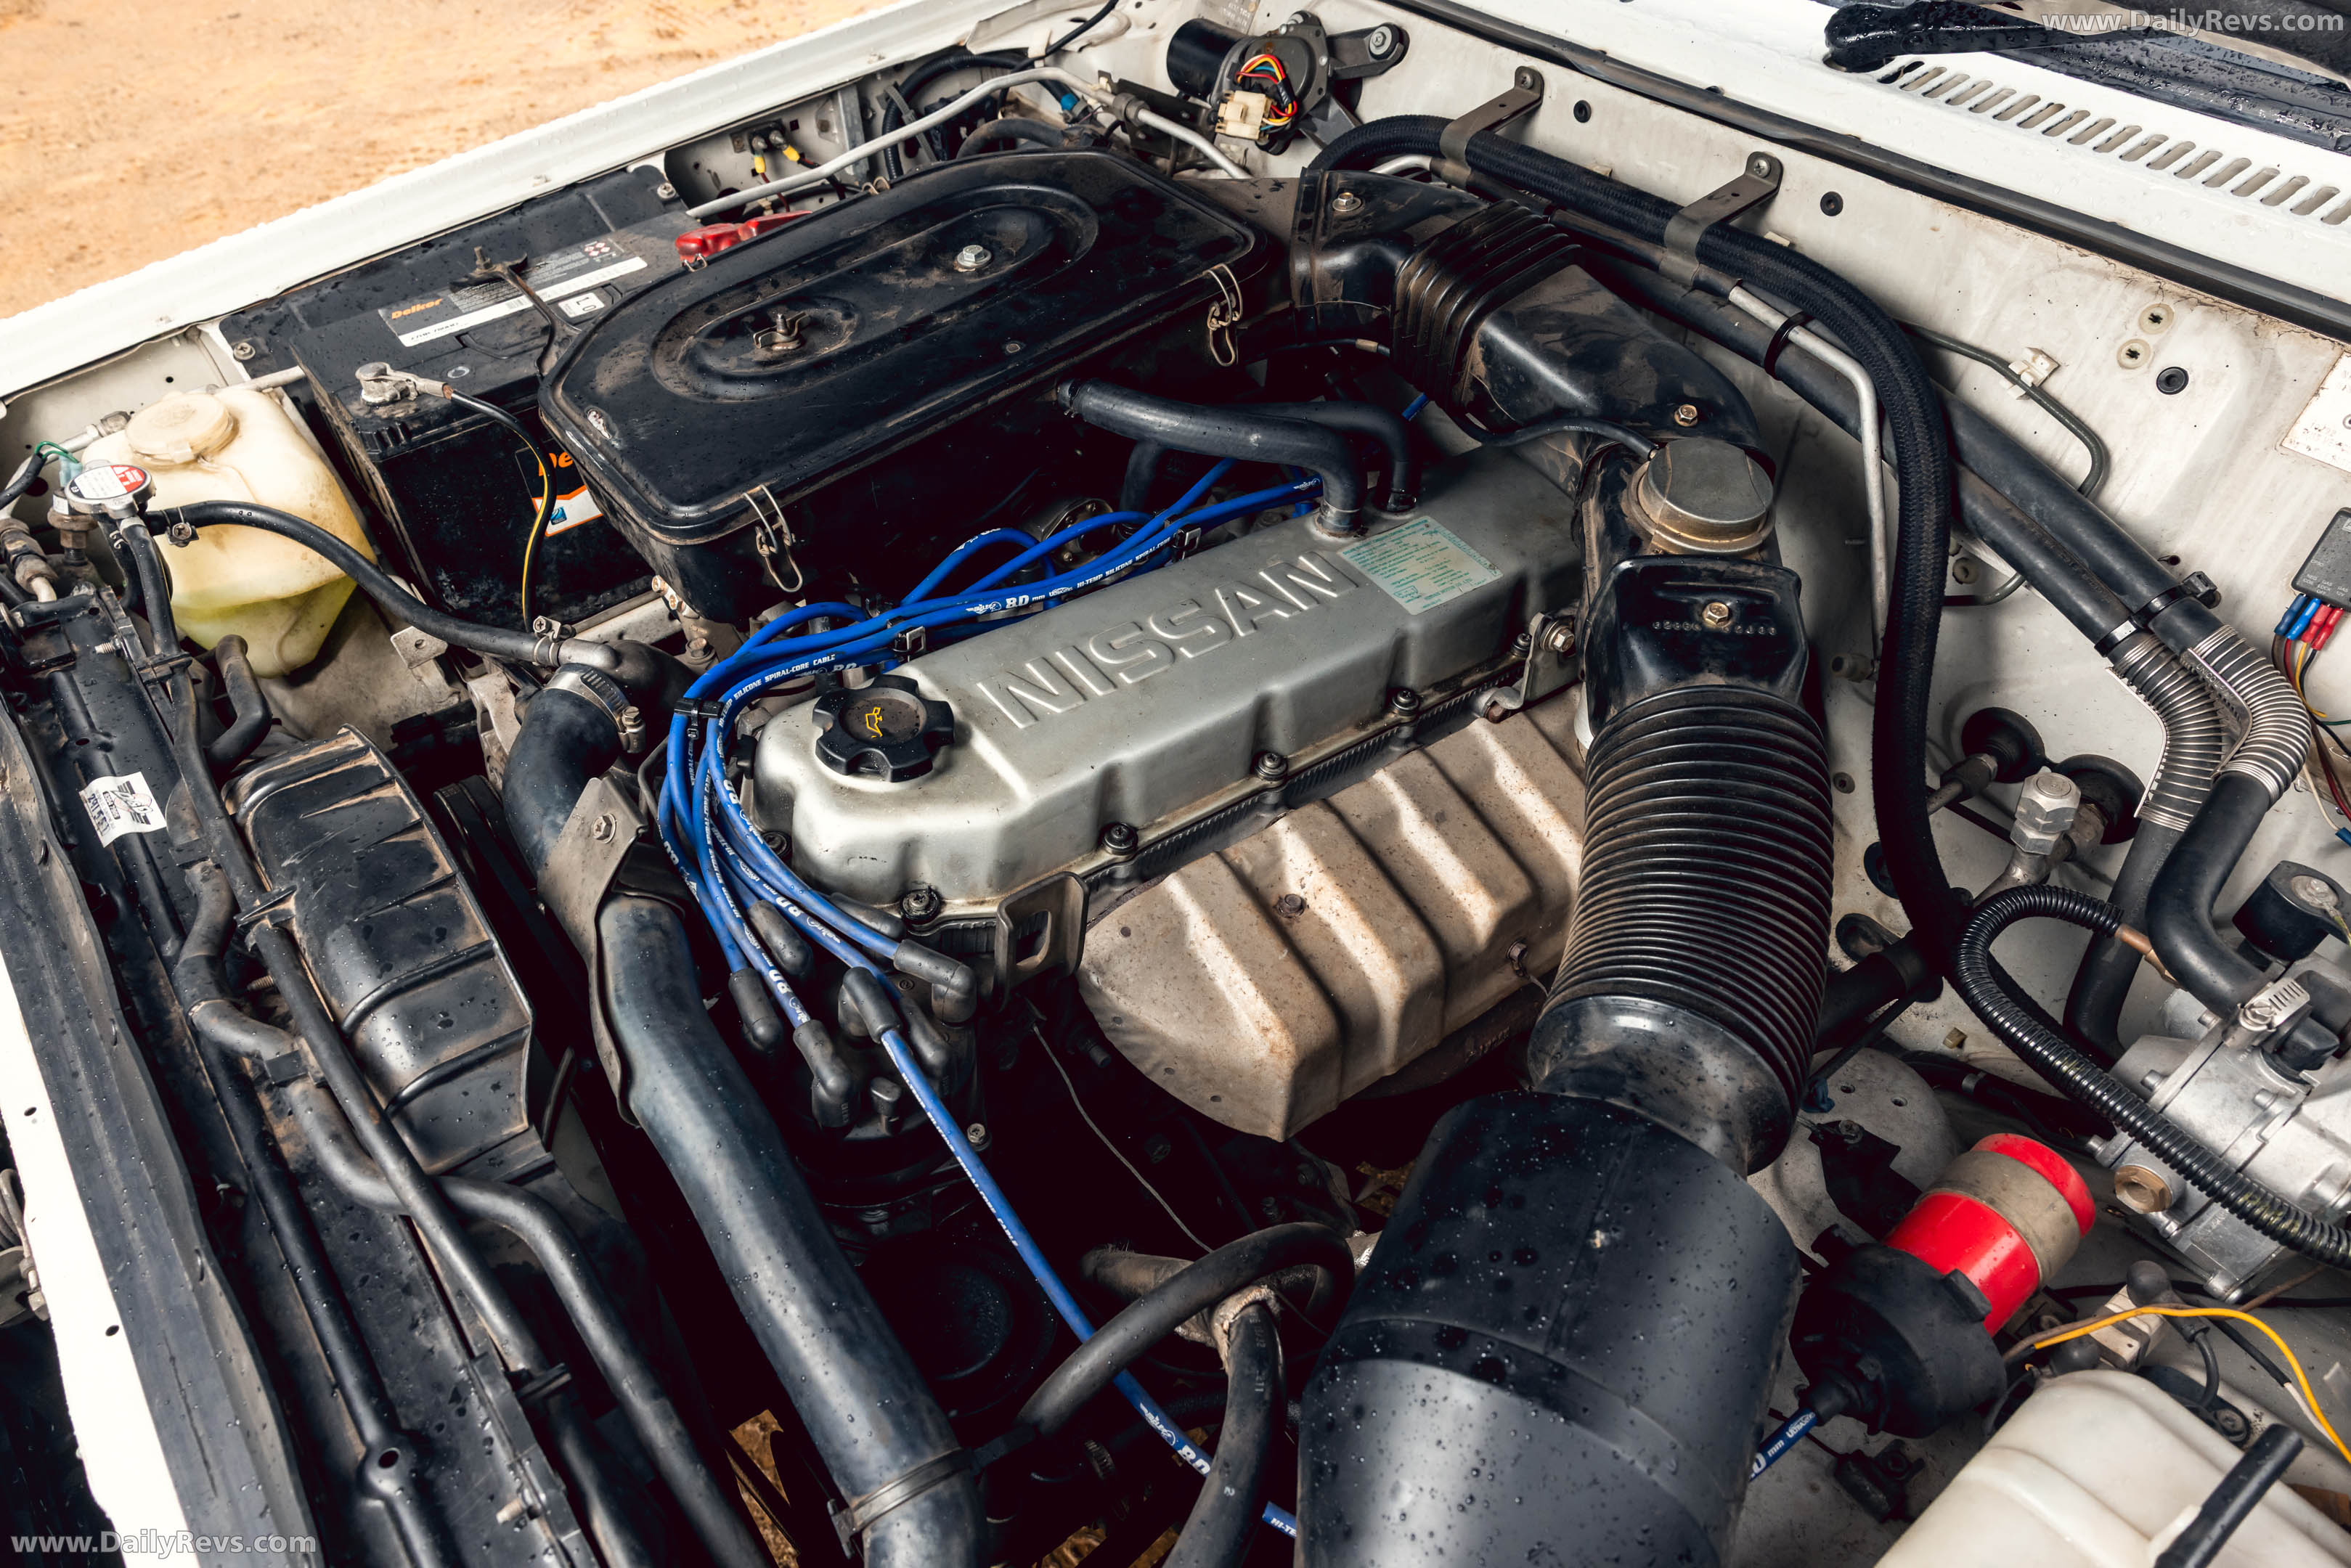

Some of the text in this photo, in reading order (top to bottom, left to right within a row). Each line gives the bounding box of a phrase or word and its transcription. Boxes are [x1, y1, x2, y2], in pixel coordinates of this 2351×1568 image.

[391, 298, 443, 319] Delkor
[1077, 573, 1103, 589] HI-TEMP
[1105, 559, 1133, 577] SILICONE
[1135, 536, 1171, 562] SPIRAL-CORE
[977, 551, 1359, 728] NISSAN
[733, 679, 762, 701] SILICONE
[764, 661, 810, 683] SPIRAL-CORE
[812, 654, 836, 666] CABLE
[1767, 1440, 1785, 1457] mm
